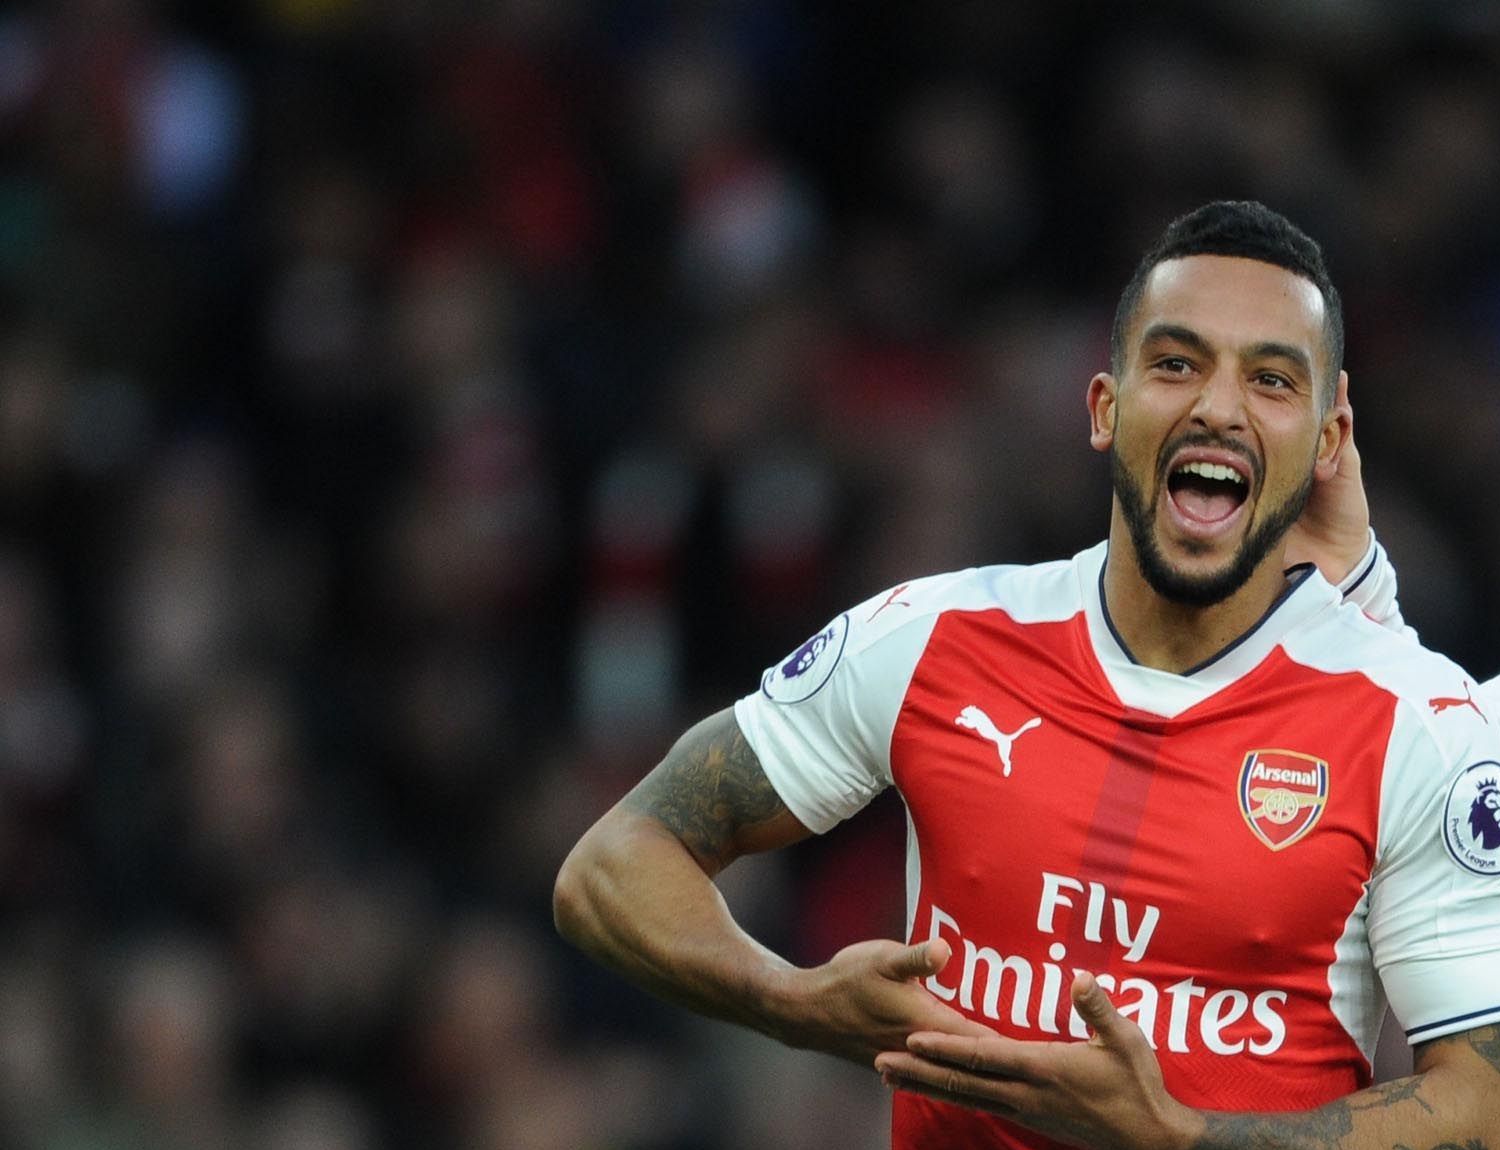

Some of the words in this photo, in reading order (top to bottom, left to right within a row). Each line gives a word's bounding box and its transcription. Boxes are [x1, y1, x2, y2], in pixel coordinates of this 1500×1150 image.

[1252, 762, 1317, 786] Arsenal
[1465, 849, 1496, 868] League
[1036, 871, 1160, 963] Fly
